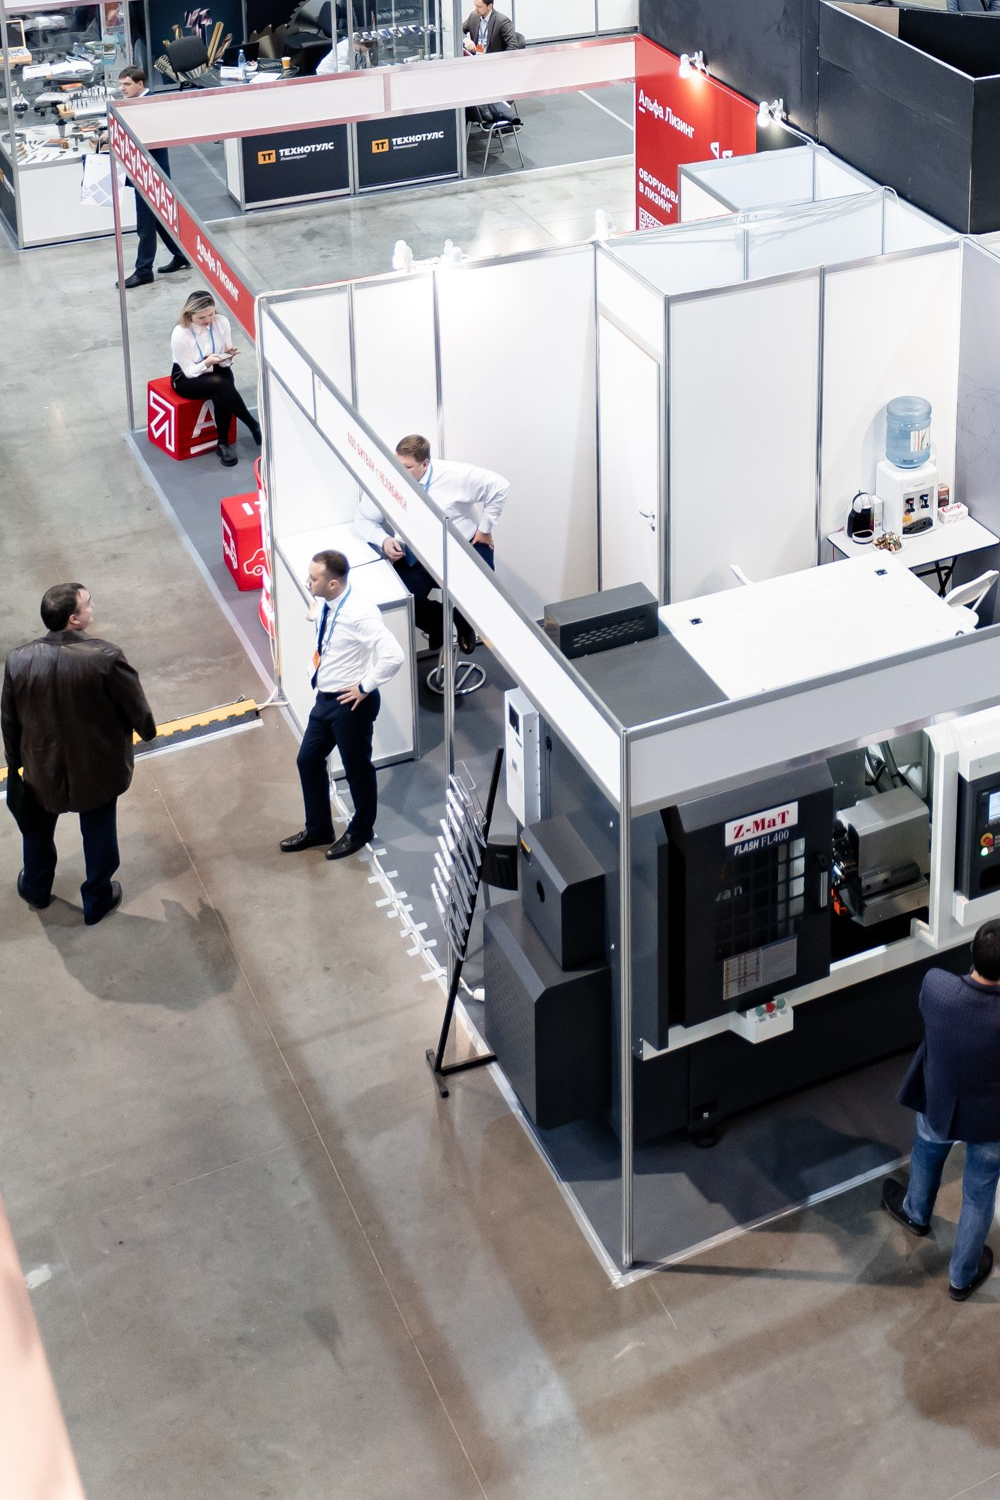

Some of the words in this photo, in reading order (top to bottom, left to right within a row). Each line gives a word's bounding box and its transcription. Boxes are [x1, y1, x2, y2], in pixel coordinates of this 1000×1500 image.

[638, 88, 664, 119] Альфа
[665, 106, 695, 139] Лизинг
[279, 142, 334, 156] ТЕХНОТУЛС
[392, 131, 444, 145] ТЕХНОТУЛС
[638, 181, 645, 193] В
[645, 185, 673, 214] ЛИЗИНГ
[733, 810, 790, 840] Z-MaT
[734, 839, 759, 856] FLASH
[761, 830, 790, 847] FL400
